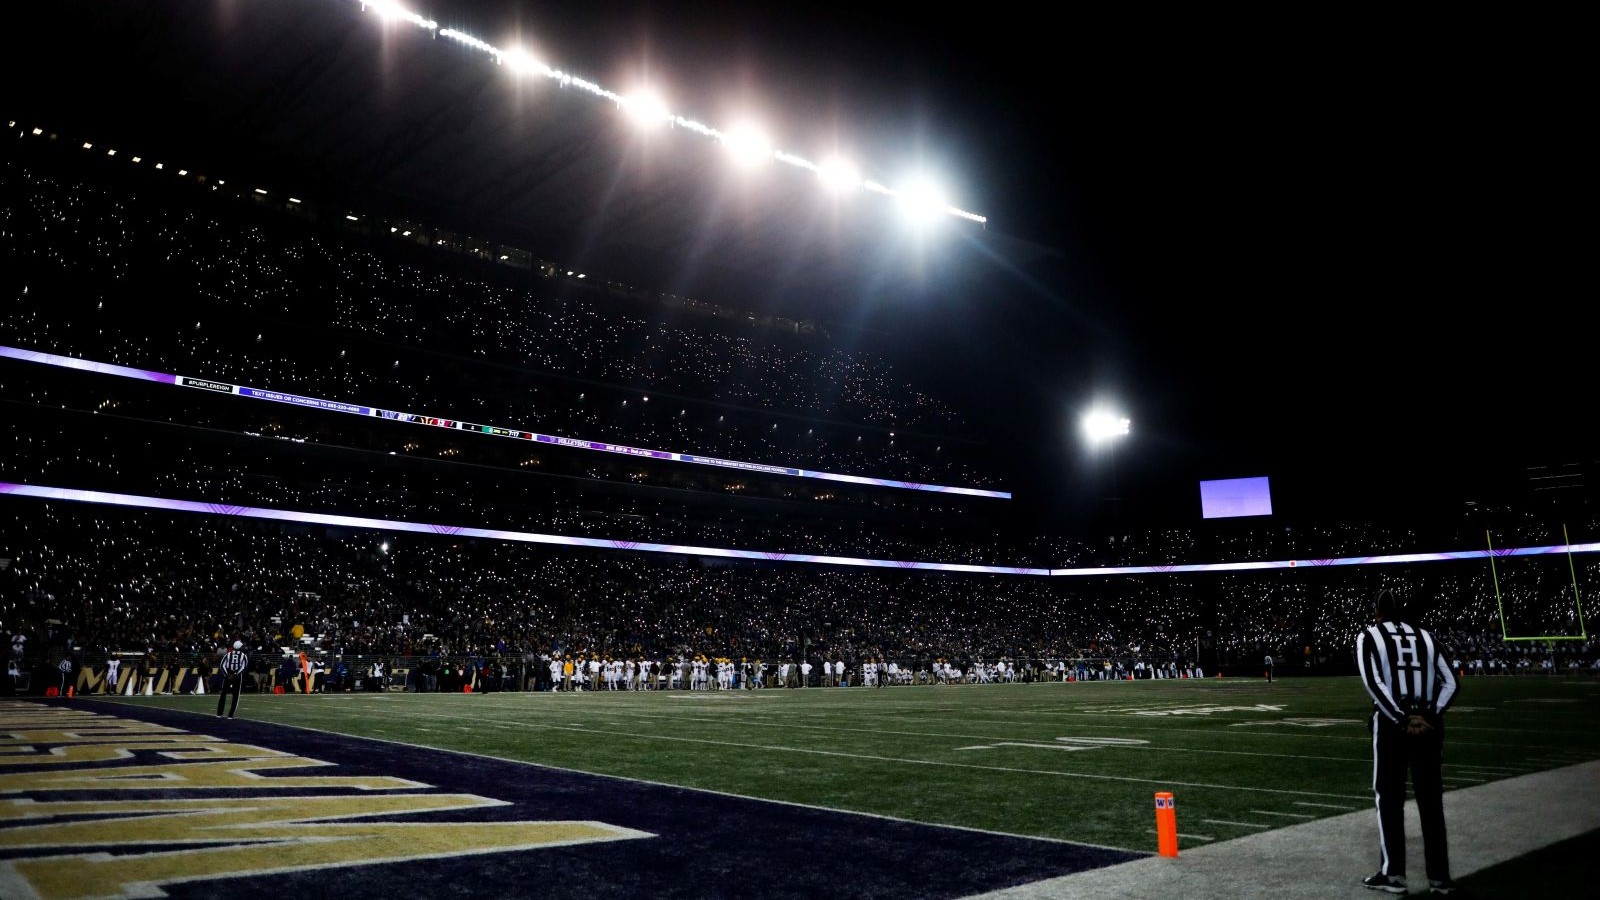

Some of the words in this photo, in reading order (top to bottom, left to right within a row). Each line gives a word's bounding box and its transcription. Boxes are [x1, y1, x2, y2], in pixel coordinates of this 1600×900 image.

[265, 392, 283, 400] ISSUES
[292, 397, 319, 406] CONCERNS
[1391, 634, 1421, 668] H
[1156, 798, 1165, 808] W
